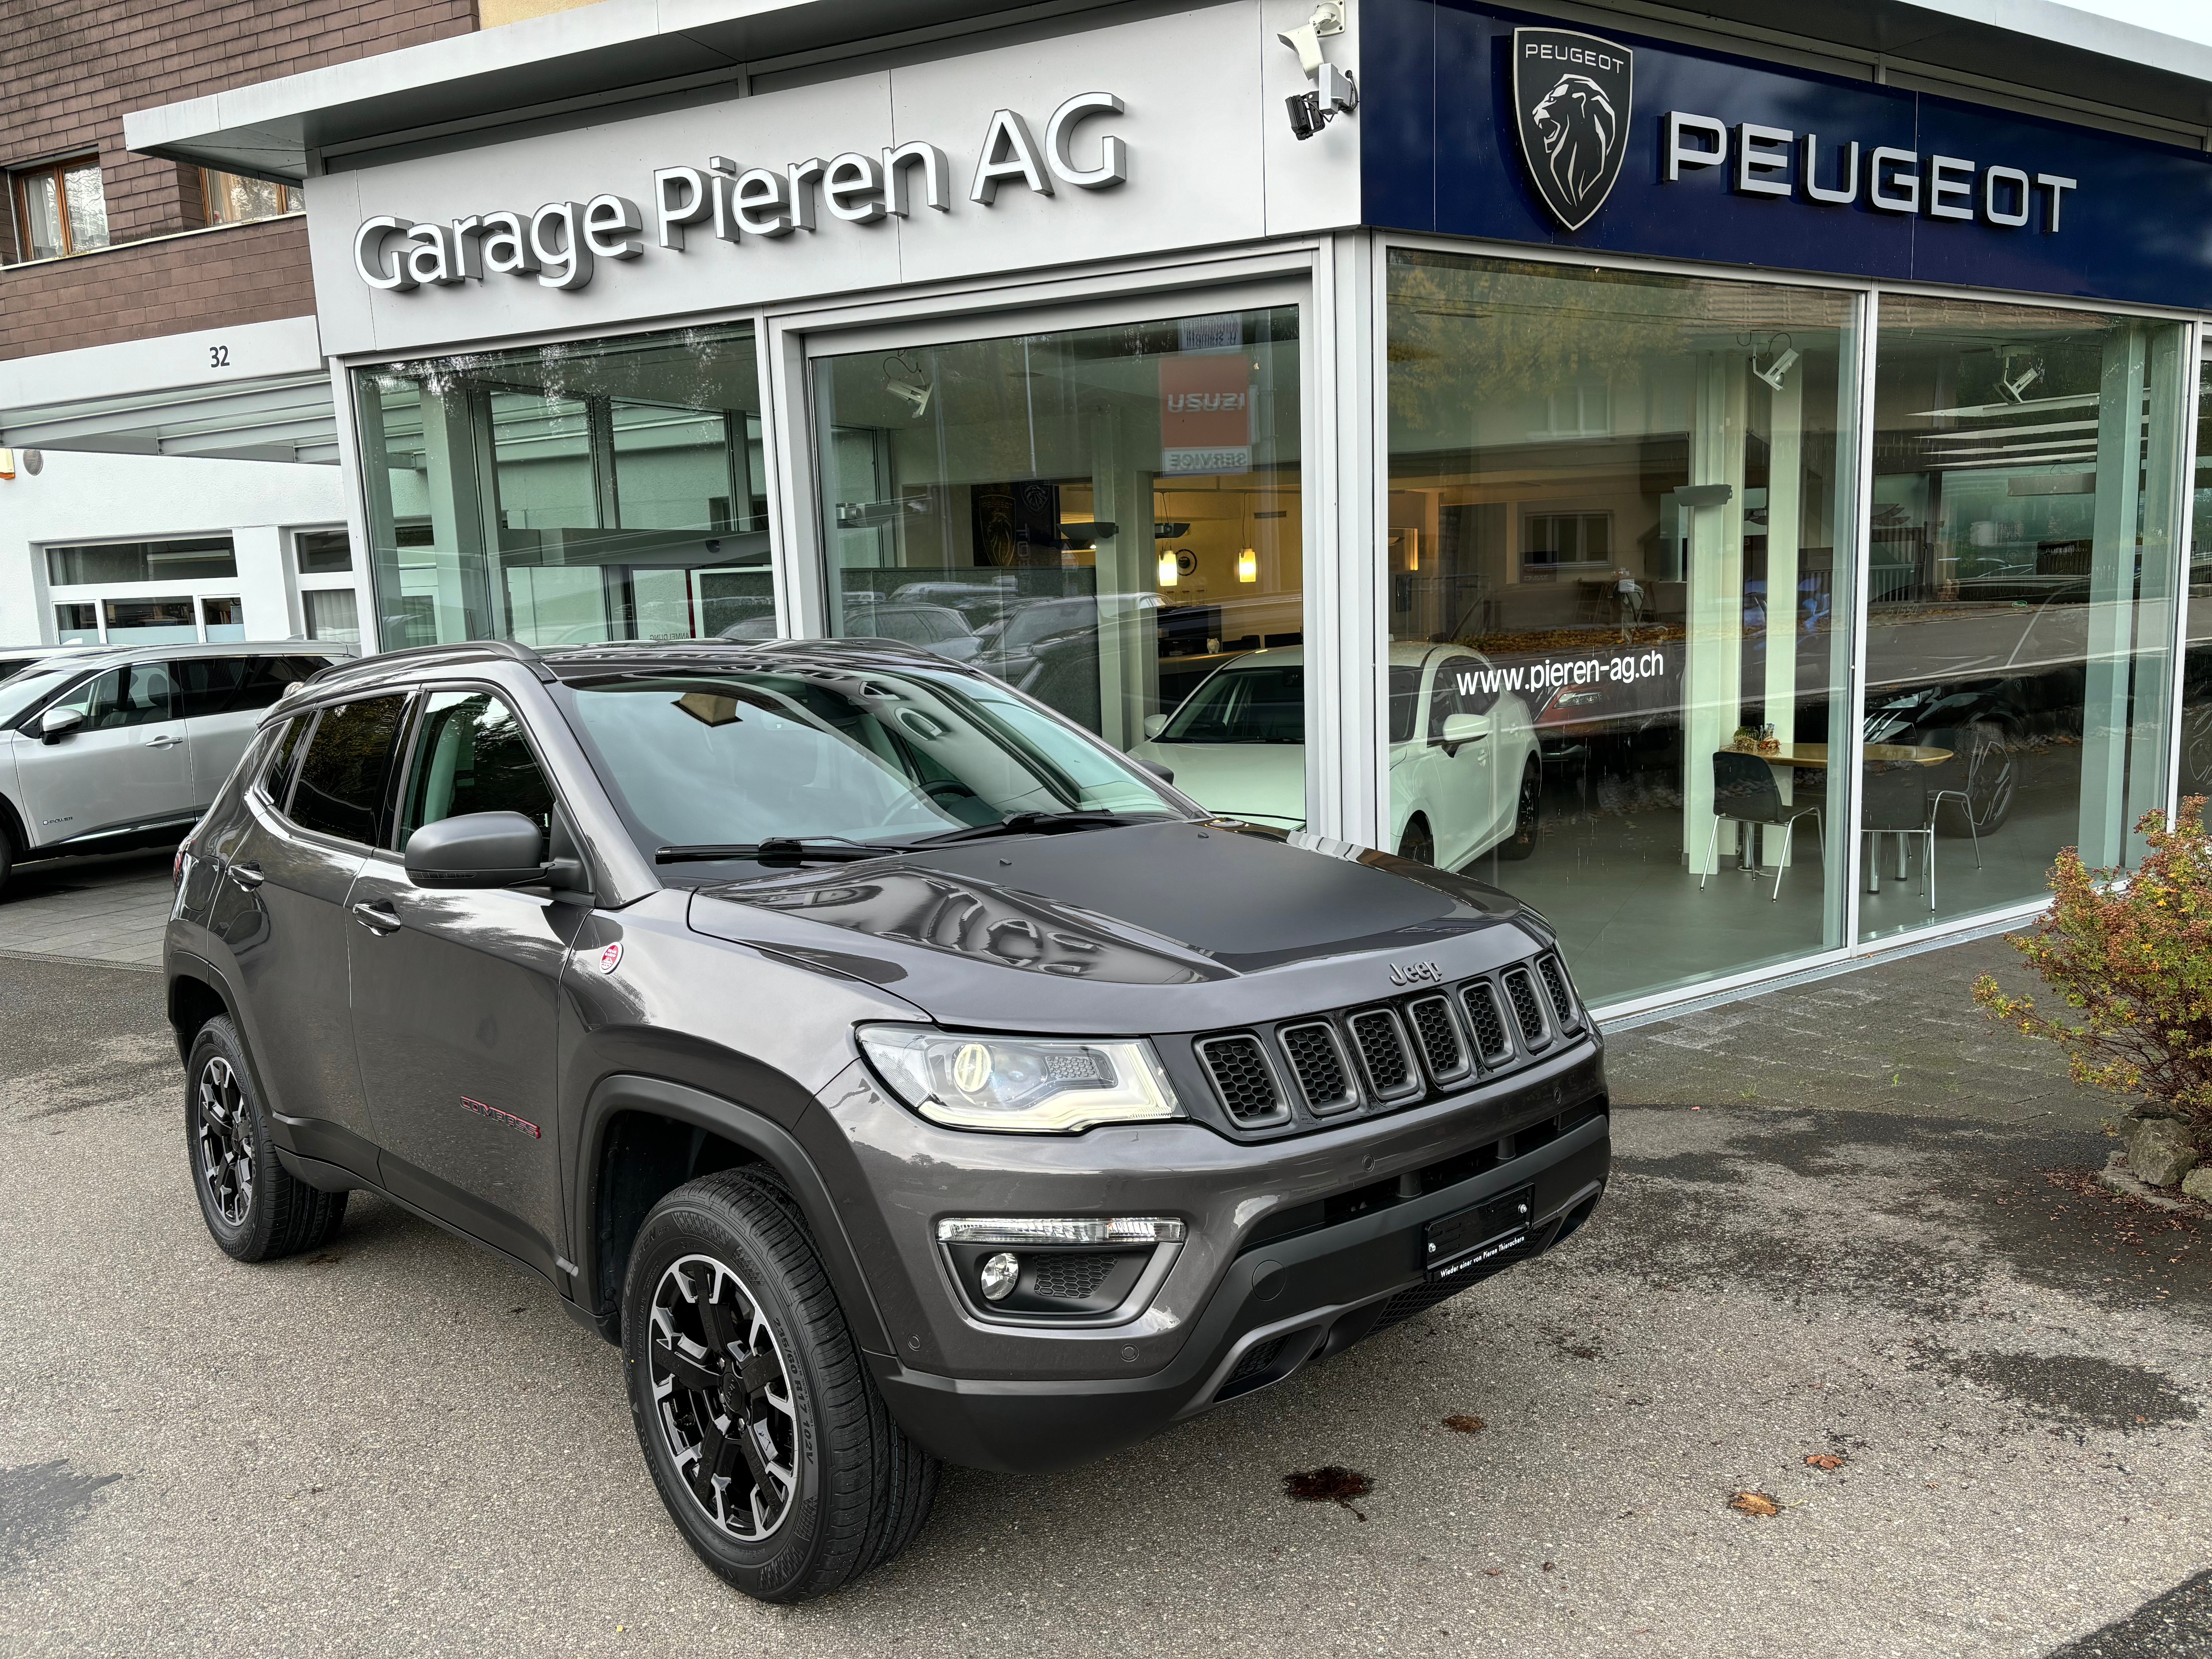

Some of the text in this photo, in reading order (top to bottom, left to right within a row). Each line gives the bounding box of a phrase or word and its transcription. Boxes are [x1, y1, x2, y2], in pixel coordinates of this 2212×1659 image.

[1525, 43, 1624, 74] PEUGEOT
[353, 91, 1127, 292] Garage Pieren AG
[1665, 110, 2077, 233] PEUGEOT
[209, 345, 230, 368] 32
[1456, 650, 1664, 696] www.pieren-ag.ch
[1389, 960, 1443, 986] Jeep
[459, 1096, 541, 1139] COMPASS
[1440, 1236, 1525, 1278] Wieder einer von Pieren Thierachern
[773, 1317, 813, 1465] 235/60 R17 102V
